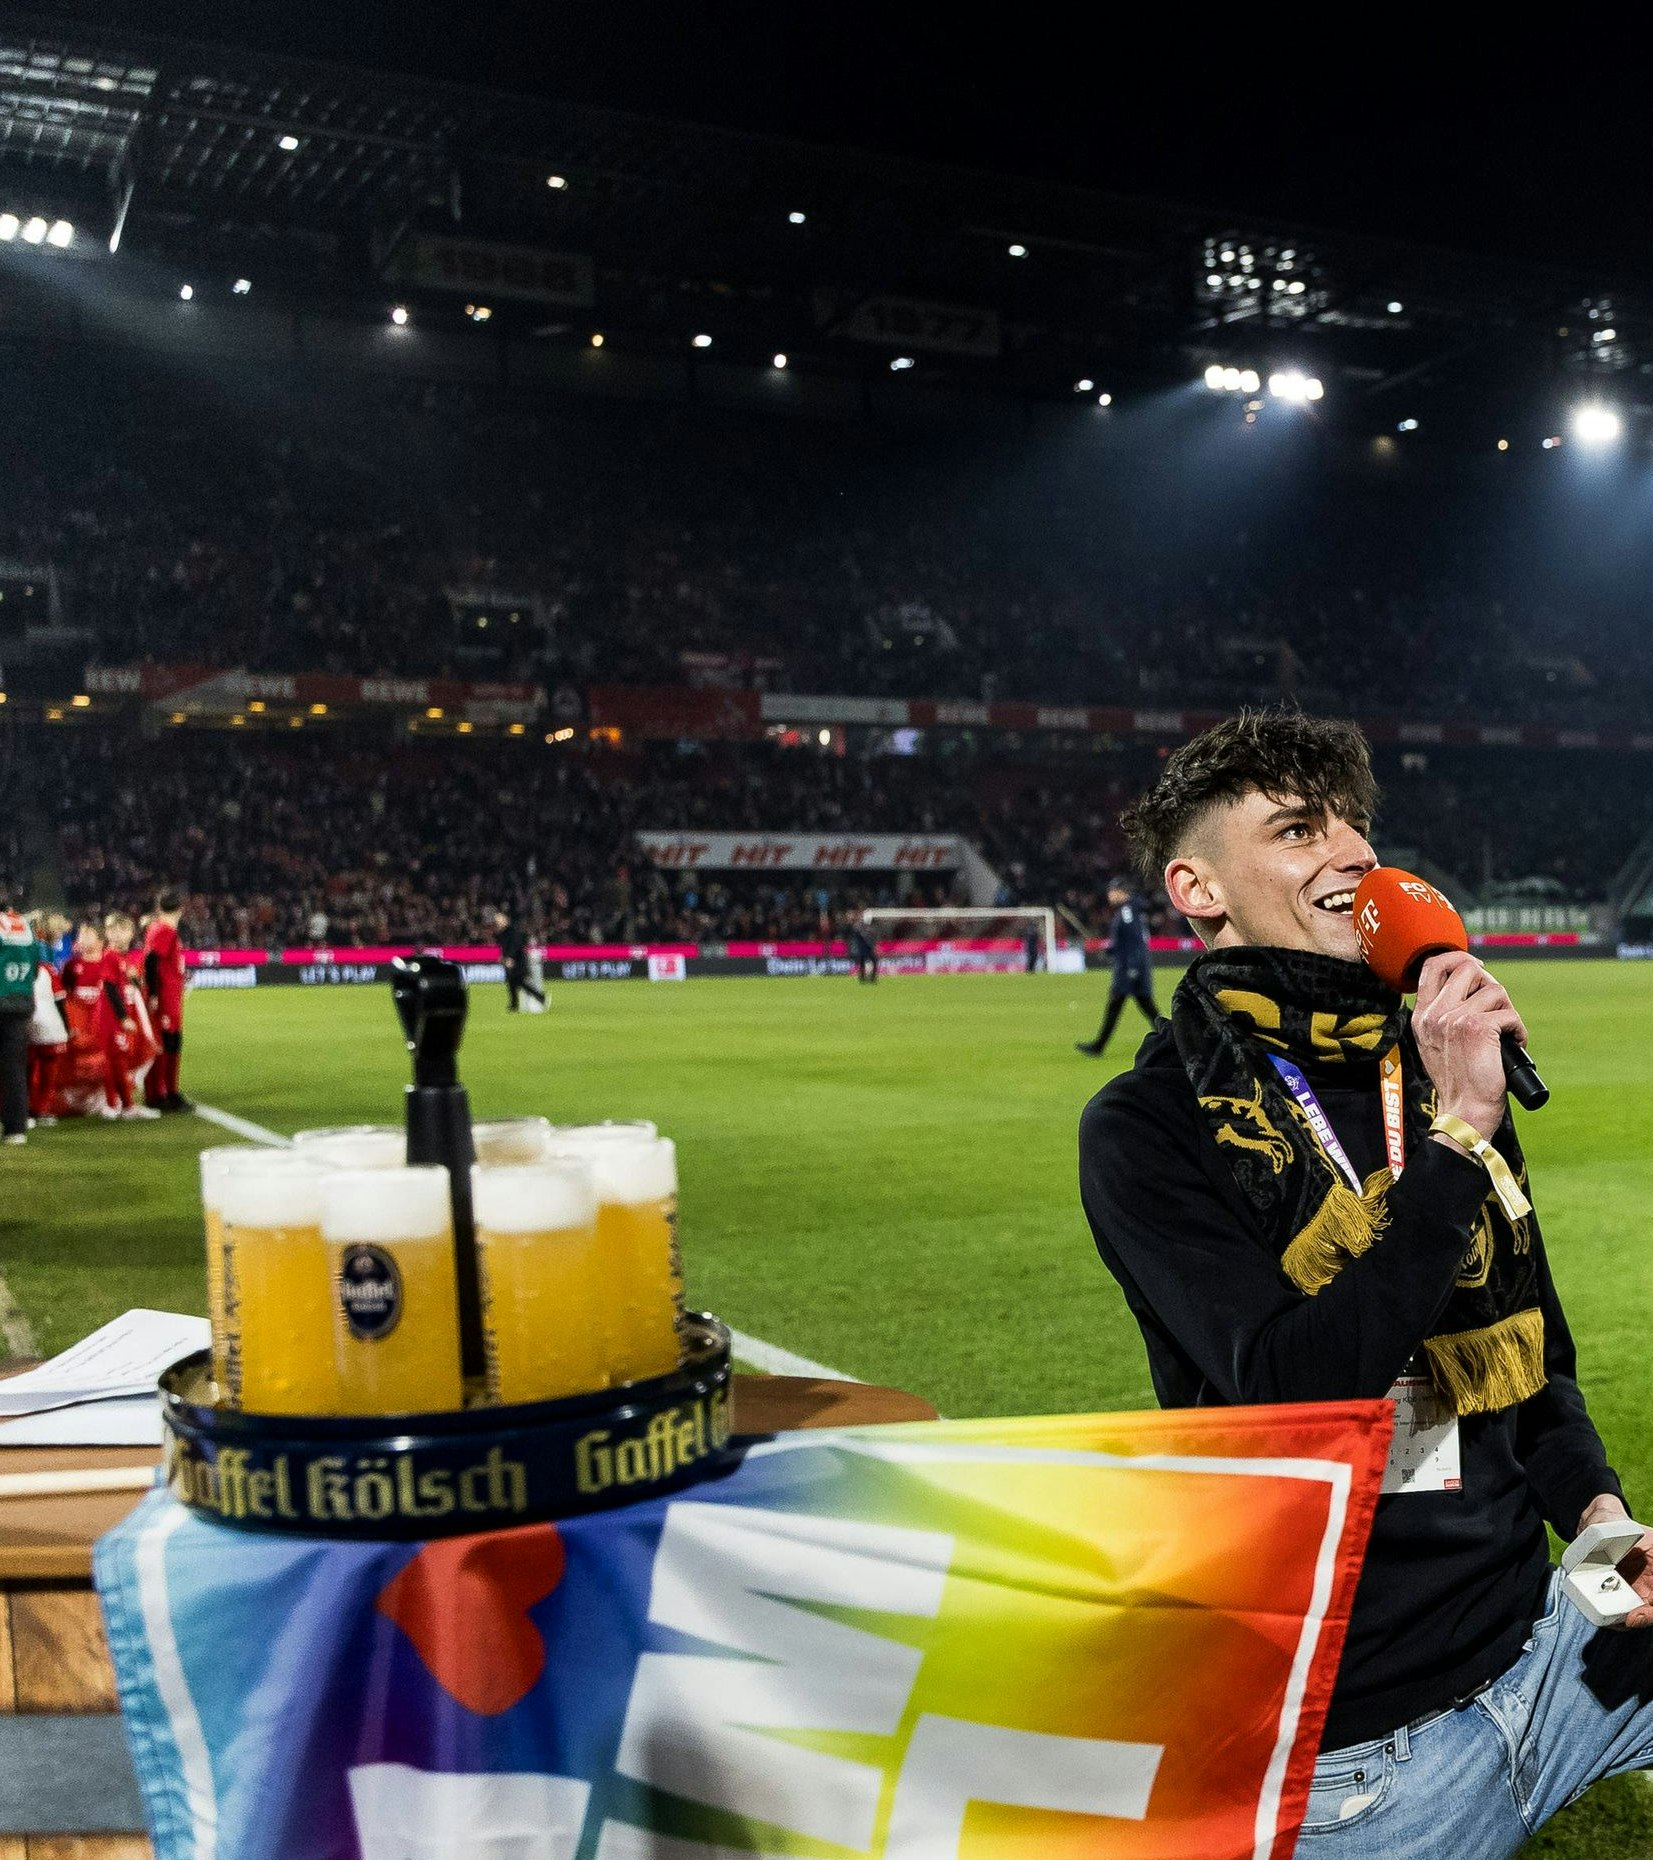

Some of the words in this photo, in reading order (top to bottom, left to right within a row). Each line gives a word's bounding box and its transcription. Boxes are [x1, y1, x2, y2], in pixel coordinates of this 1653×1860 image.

[730, 843, 794, 866] HIT
[812, 844, 877, 866] HIT
[5, 961, 32, 983] 07
[1296, 1091, 1334, 1145] LEBE
[1383, 1077, 1401, 1129] BIST
[1387, 1130, 1403, 1163] DU
[573, 1400, 709, 1494] Gaffel
[305, 1445, 529, 1520] Kölsch
